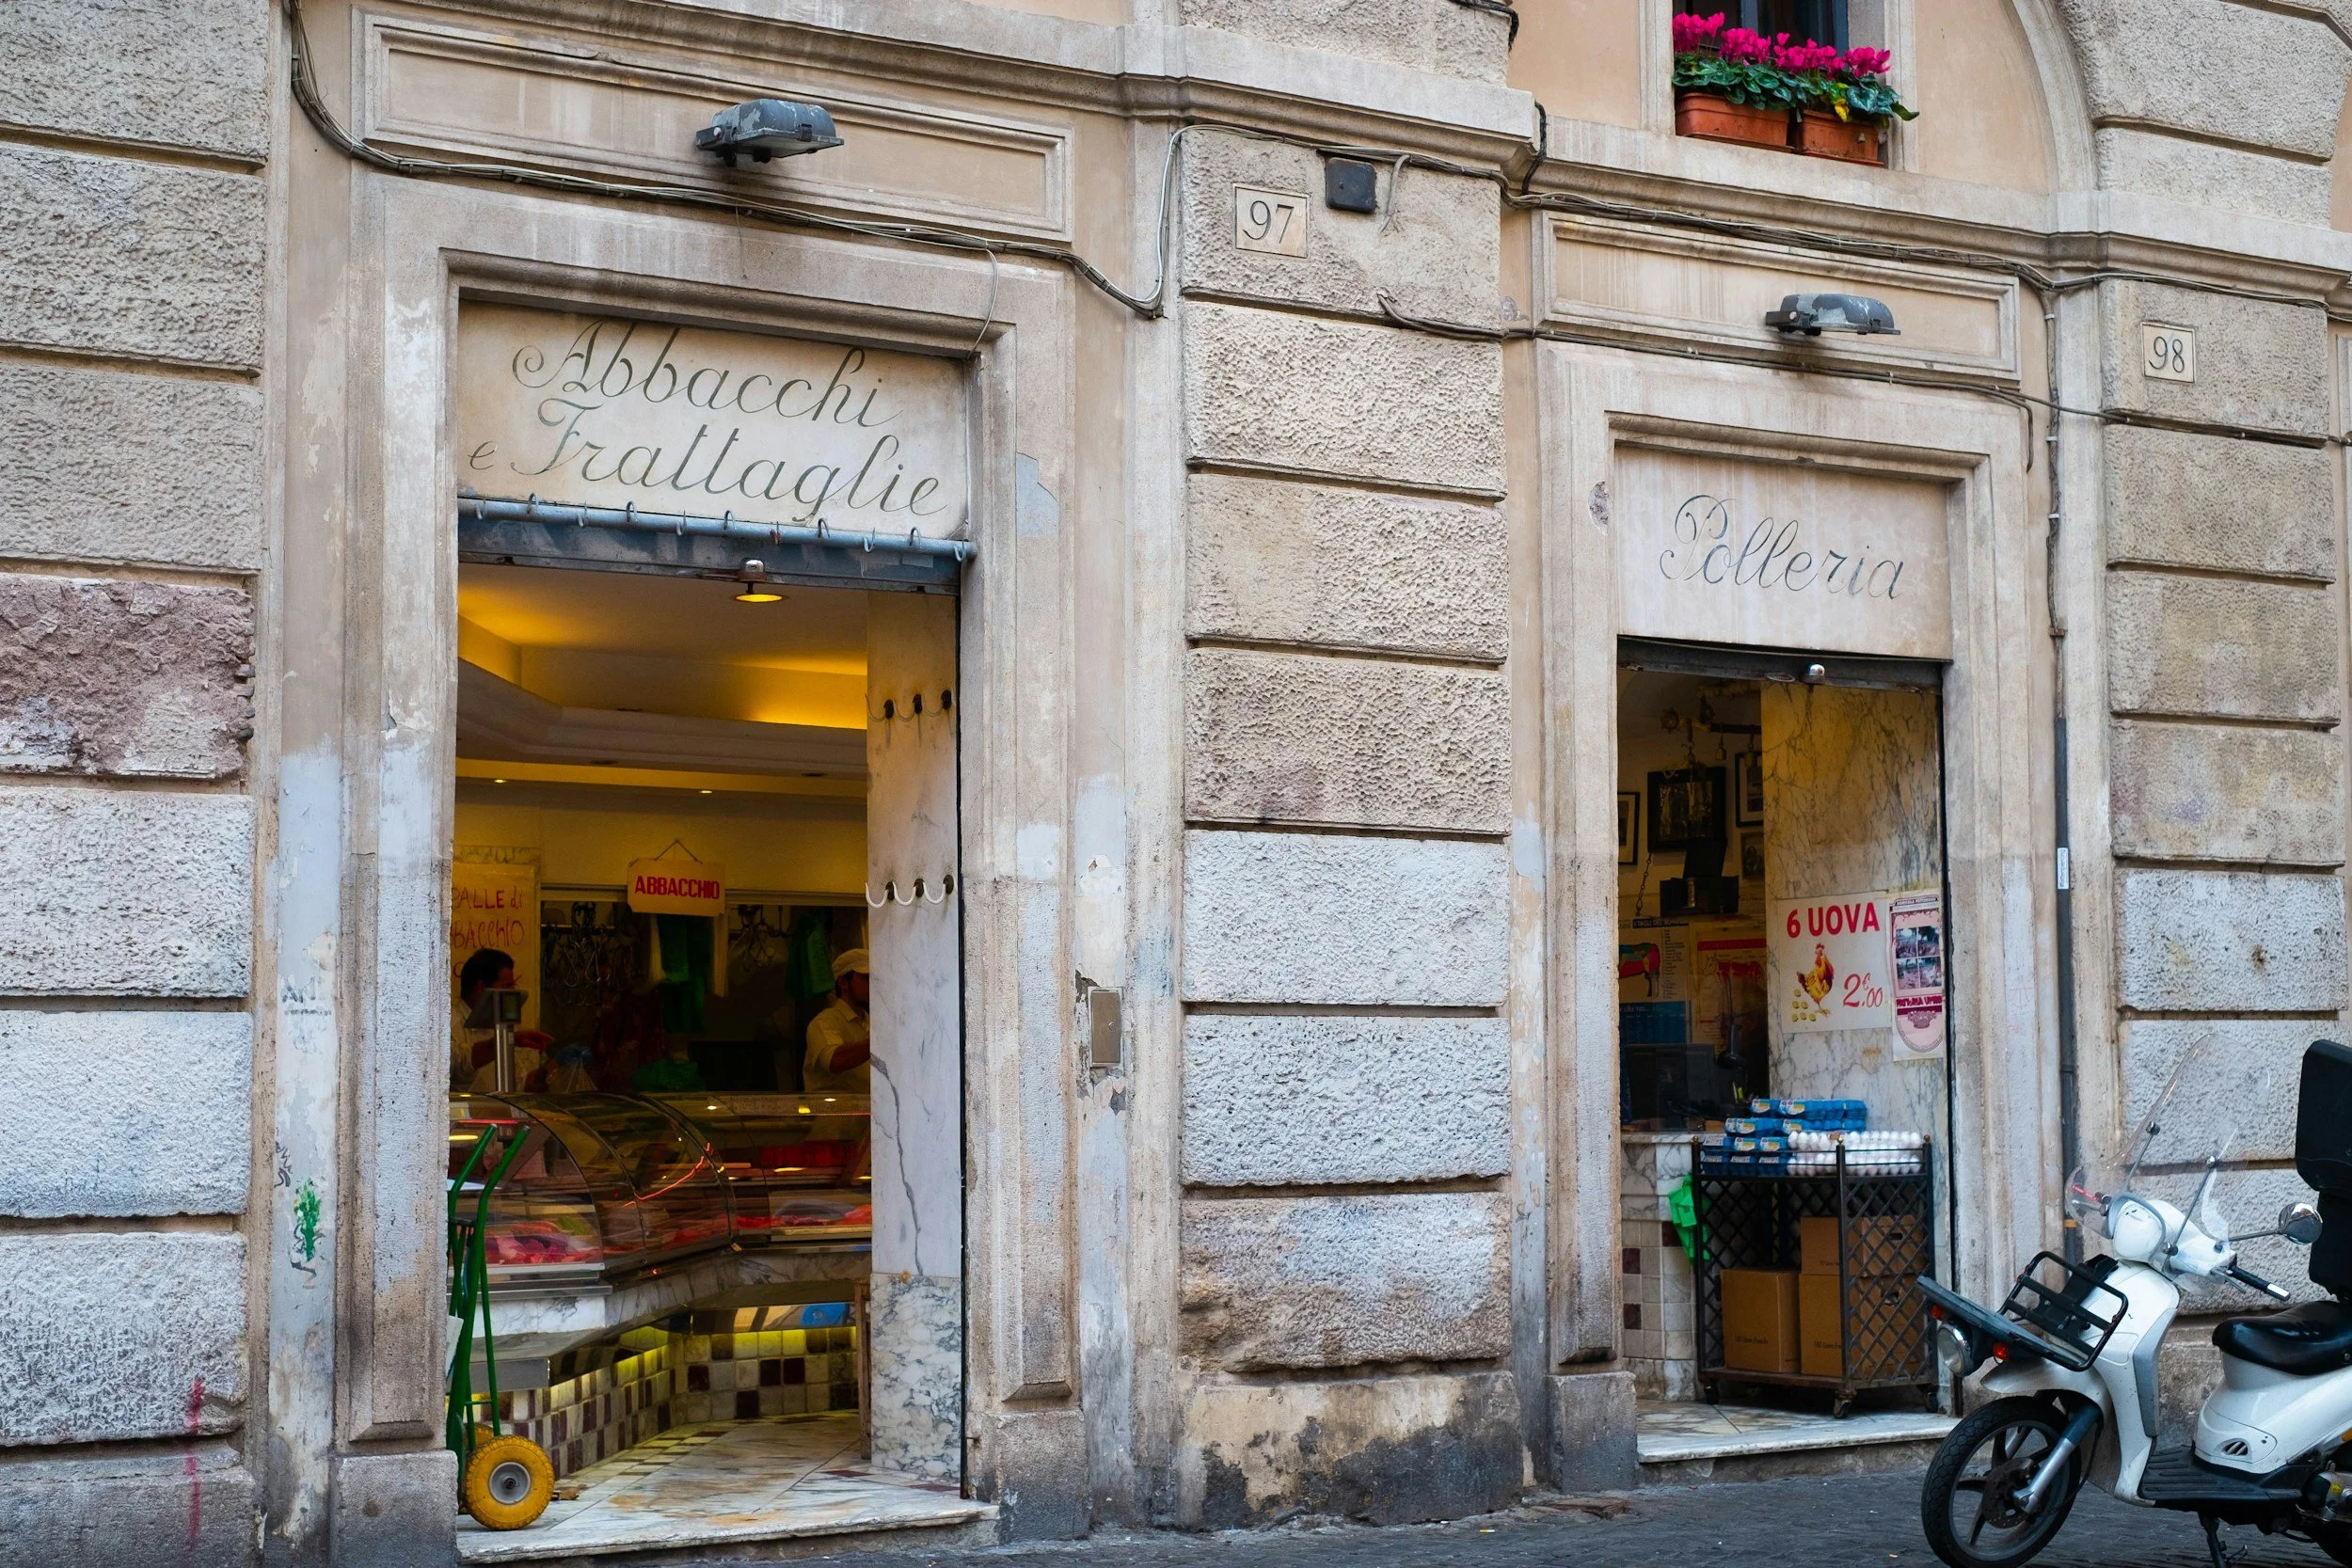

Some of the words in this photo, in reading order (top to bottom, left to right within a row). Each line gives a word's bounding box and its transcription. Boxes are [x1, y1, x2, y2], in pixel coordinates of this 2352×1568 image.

[1242, 199, 1295, 245] 97
[512, 318, 904, 428] Abbacchi
[2148, 335, 2185, 373] 98
[469, 439, 499, 471] e
[510, 396, 948, 523] Frattaglie
[1659, 494, 1904, 600] Polleria
[634, 875, 721, 900] ABBACCHIO
[1786, 908, 1802, 939] 6
[1807, 901, 1881, 938] UOVA
